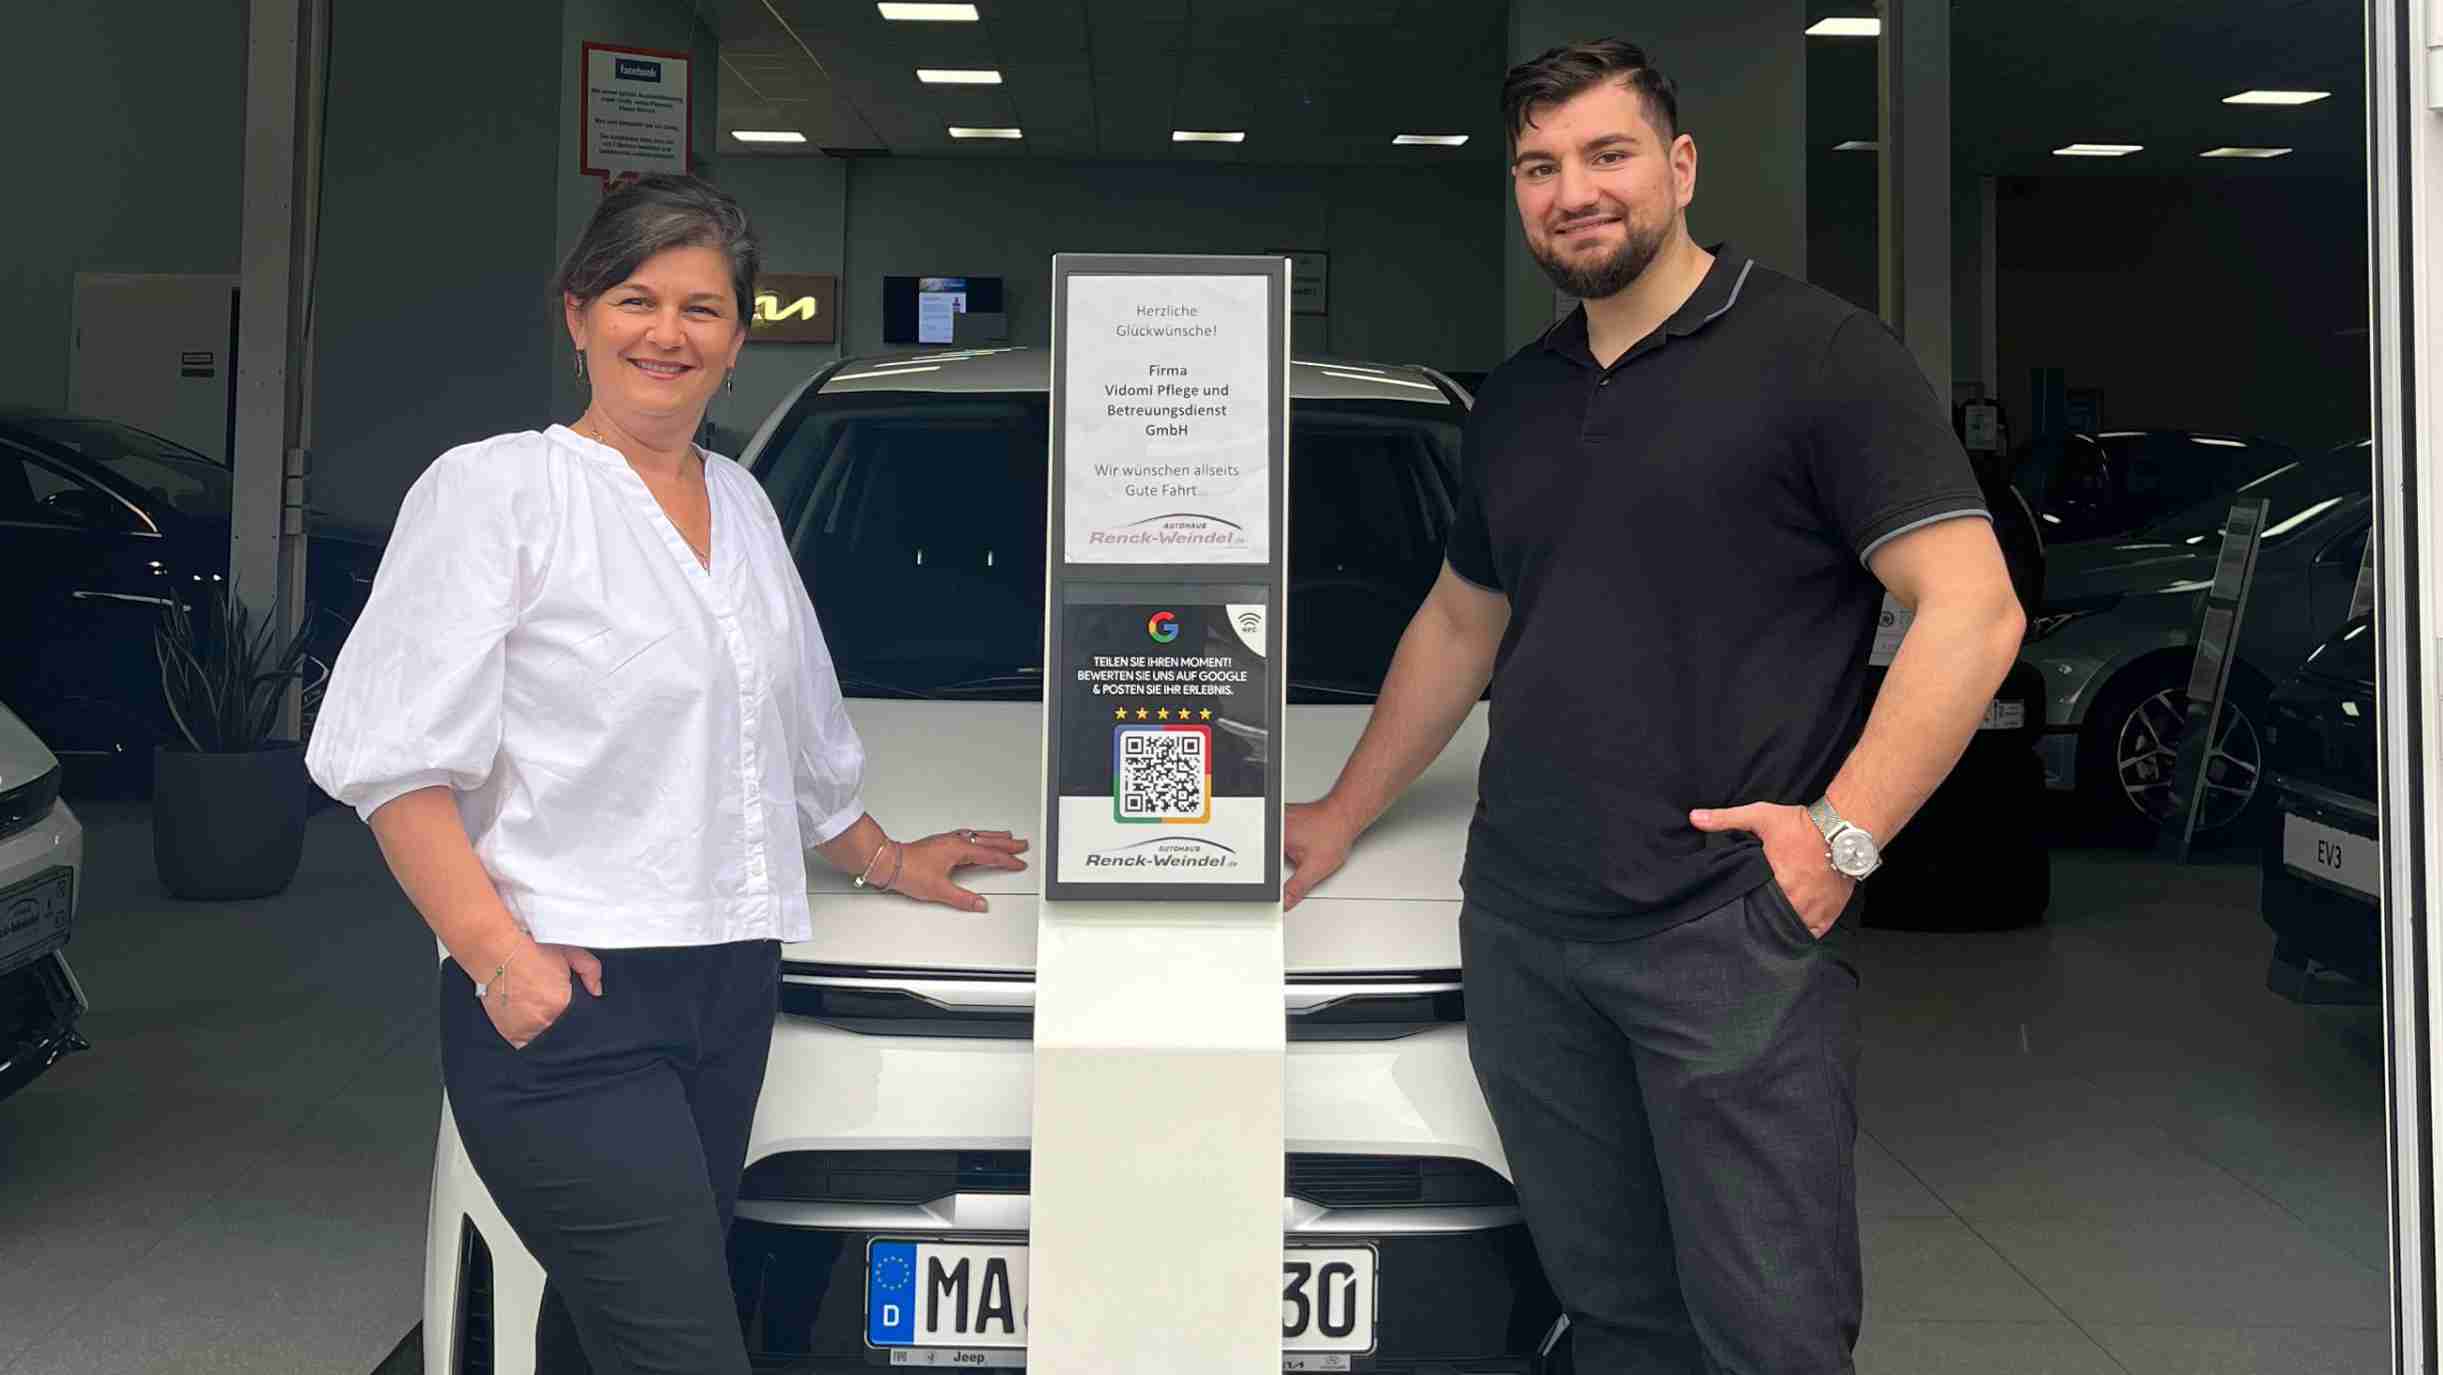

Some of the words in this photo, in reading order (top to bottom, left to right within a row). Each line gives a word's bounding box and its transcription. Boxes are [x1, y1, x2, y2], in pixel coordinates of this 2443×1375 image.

[1136, 304, 1198, 317] Herzliche
[1116, 324, 1217, 337] Glückwünsche!
[1149, 364, 1187, 376] Firma
[1104, 384, 1153, 396] Vidomi
[1157, 384, 1199, 398] Pflege
[1203, 384, 1229, 396] und
[1107, 404, 1227, 418] Betreuungsdienst
[1145, 424, 1188, 436] GmbH
[1094, 463, 1119, 476] Wir
[1122, 463, 1190, 476] wünschen
[1194, 463, 1239, 476] allseits
[1125, 484, 1158, 496] Gute
[1094, 656, 1127, 667] TEILEN
[1130, 656, 1146, 667] SIE
[1148, 656, 1178, 667] IHREN
[1181, 656, 1232, 667] MOMENT!
[1077, 670, 1132, 681] BEWERTEN
[1135, 671, 1150, 681] SIE
[1153, 671, 1174, 681] UNS
[1176, 671, 1197, 681] AUF
[1199, 671, 1247, 682] GOOGLE
[1093, 684, 1101, 695] &
[1102, 684, 1144, 695] POSTEN
[1147, 684, 1161, 695] SIE
[1164, 684, 1181, 695] IHR
[1183, 684, 1233, 695] ERLEBNIS.
[2318, 840, 2342, 869] EV3
[883, 1305, 899, 1327] D
[953, 1351, 985, 1365] Jeep
